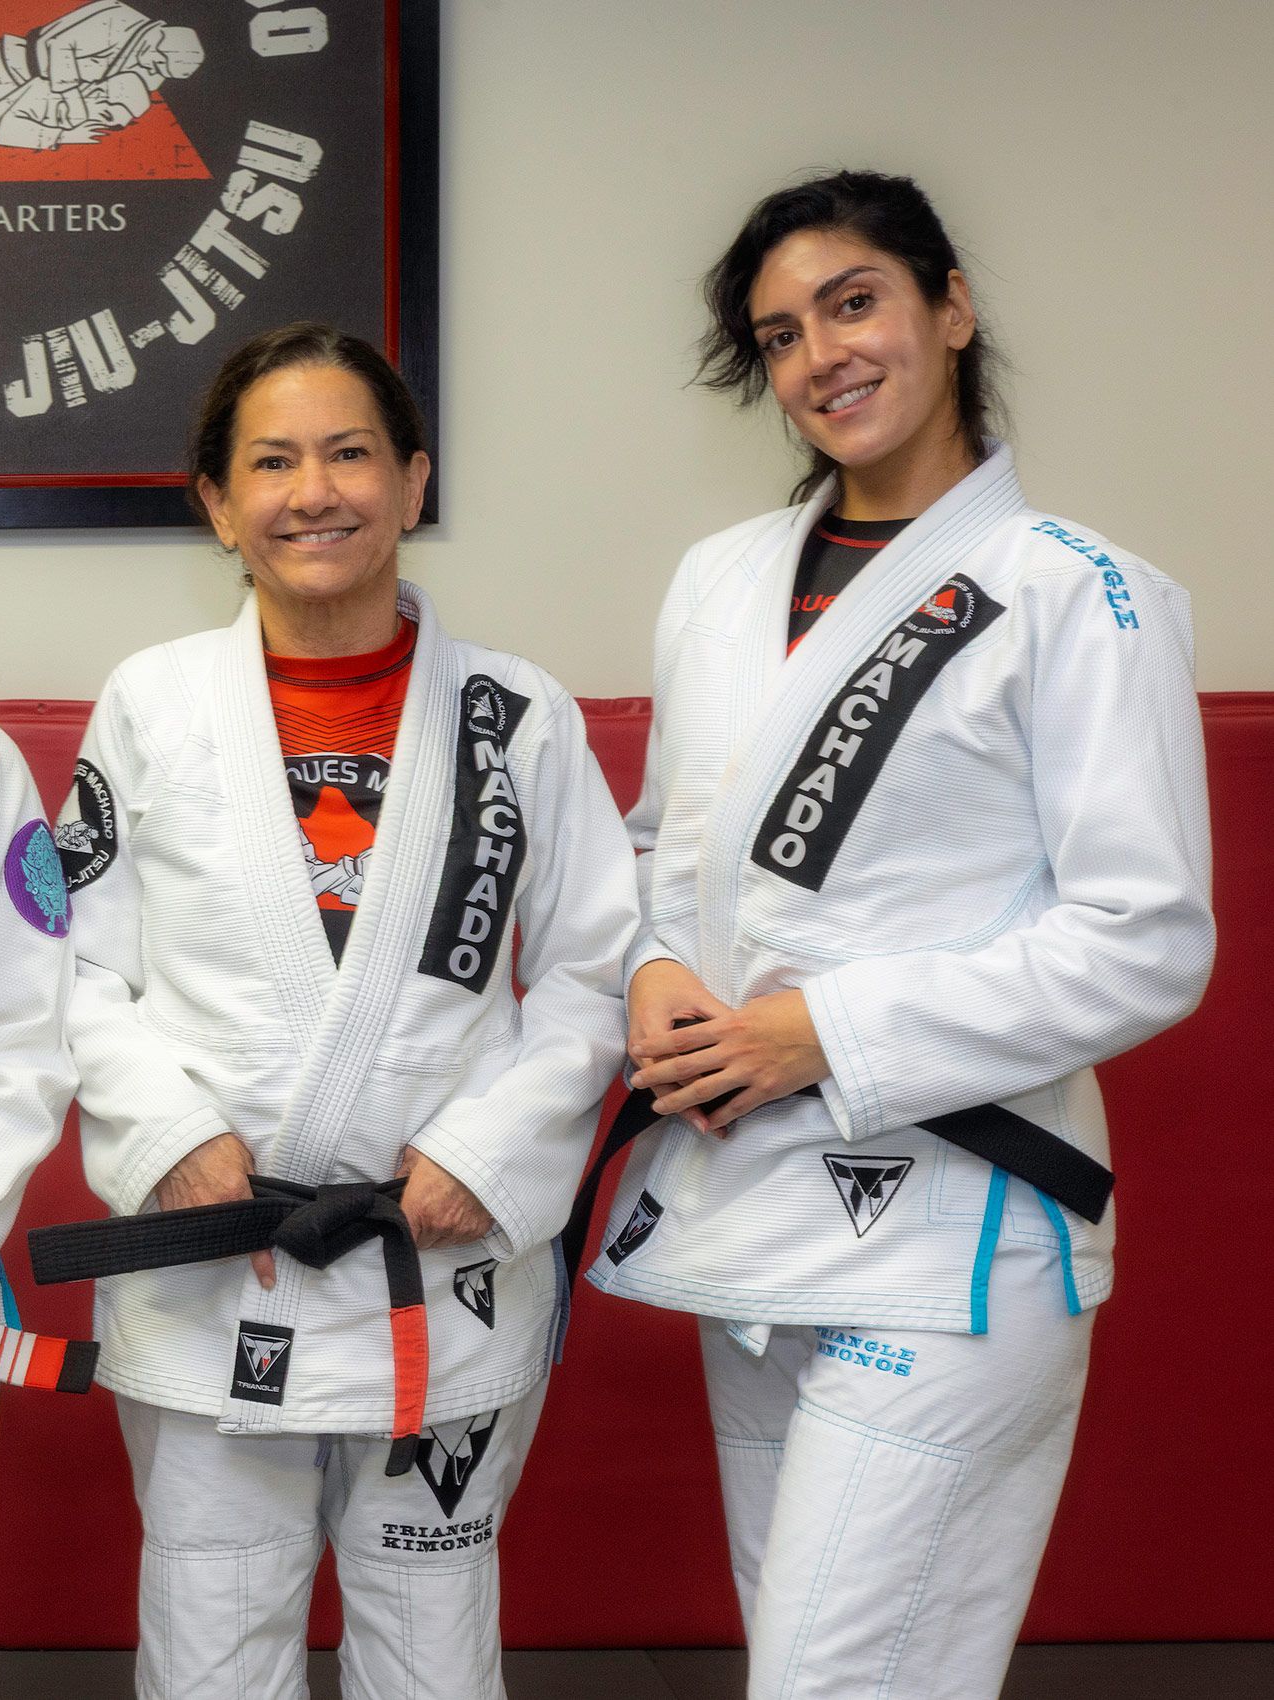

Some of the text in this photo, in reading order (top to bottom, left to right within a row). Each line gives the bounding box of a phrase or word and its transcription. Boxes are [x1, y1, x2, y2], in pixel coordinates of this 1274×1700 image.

[3, 119, 325, 419] JIU-JITSU
[1030, 520, 1140, 631] TRIANGLE
[768, 632, 929, 869] MACHADO
[85, 771, 114, 840] MACHADO
[448, 740, 519, 980] MACHADO
[237, 1381, 280, 1393] TRIANGLE
[382, 1513, 493, 1538] TRIANGLE
[382, 1527, 493, 1553] KIMONOS
